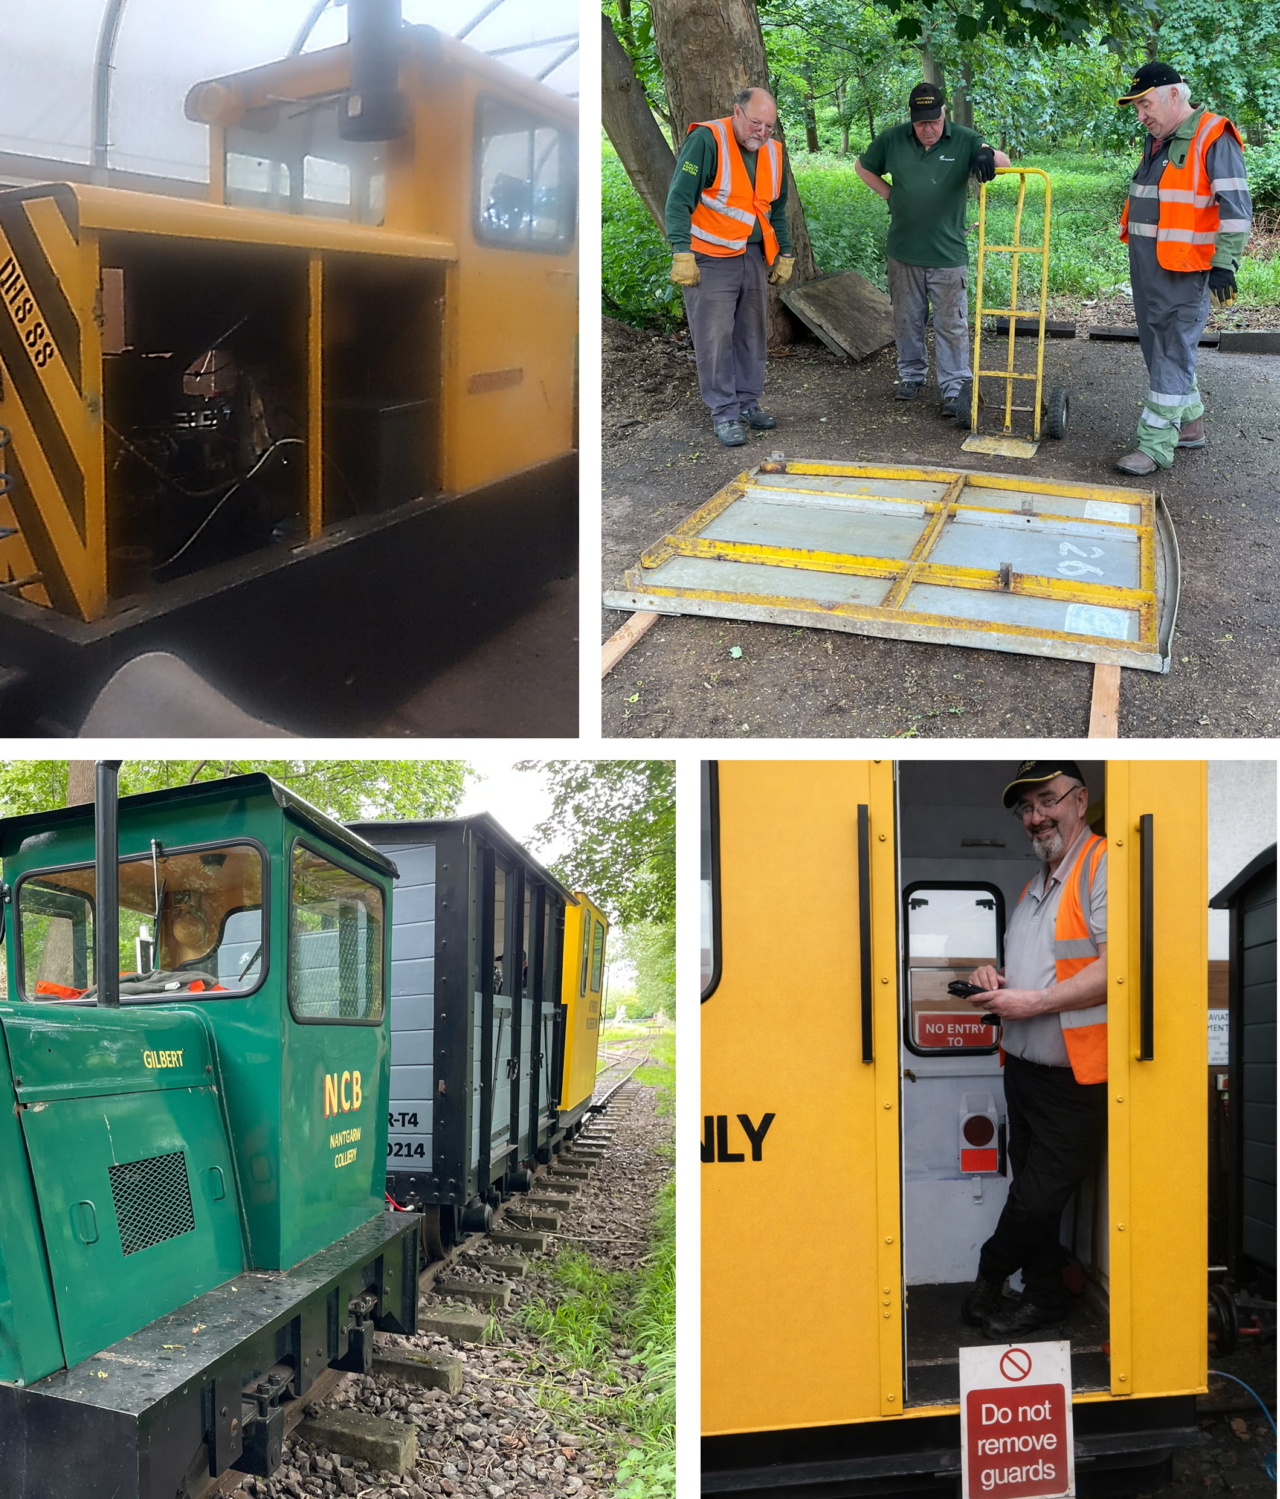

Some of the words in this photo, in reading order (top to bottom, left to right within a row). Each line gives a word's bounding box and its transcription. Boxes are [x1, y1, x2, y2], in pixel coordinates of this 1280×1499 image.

[925, 1023, 945, 1034] NO
[947, 1023, 987, 1034] ENTRY
[947, 1036, 963, 1047] TO
[981, 1403, 1013, 1426] Do
[1018, 1399, 1052, 1422] not
[977, 1433, 1057, 1456] remove
[980, 1458, 1056, 1491] guards
